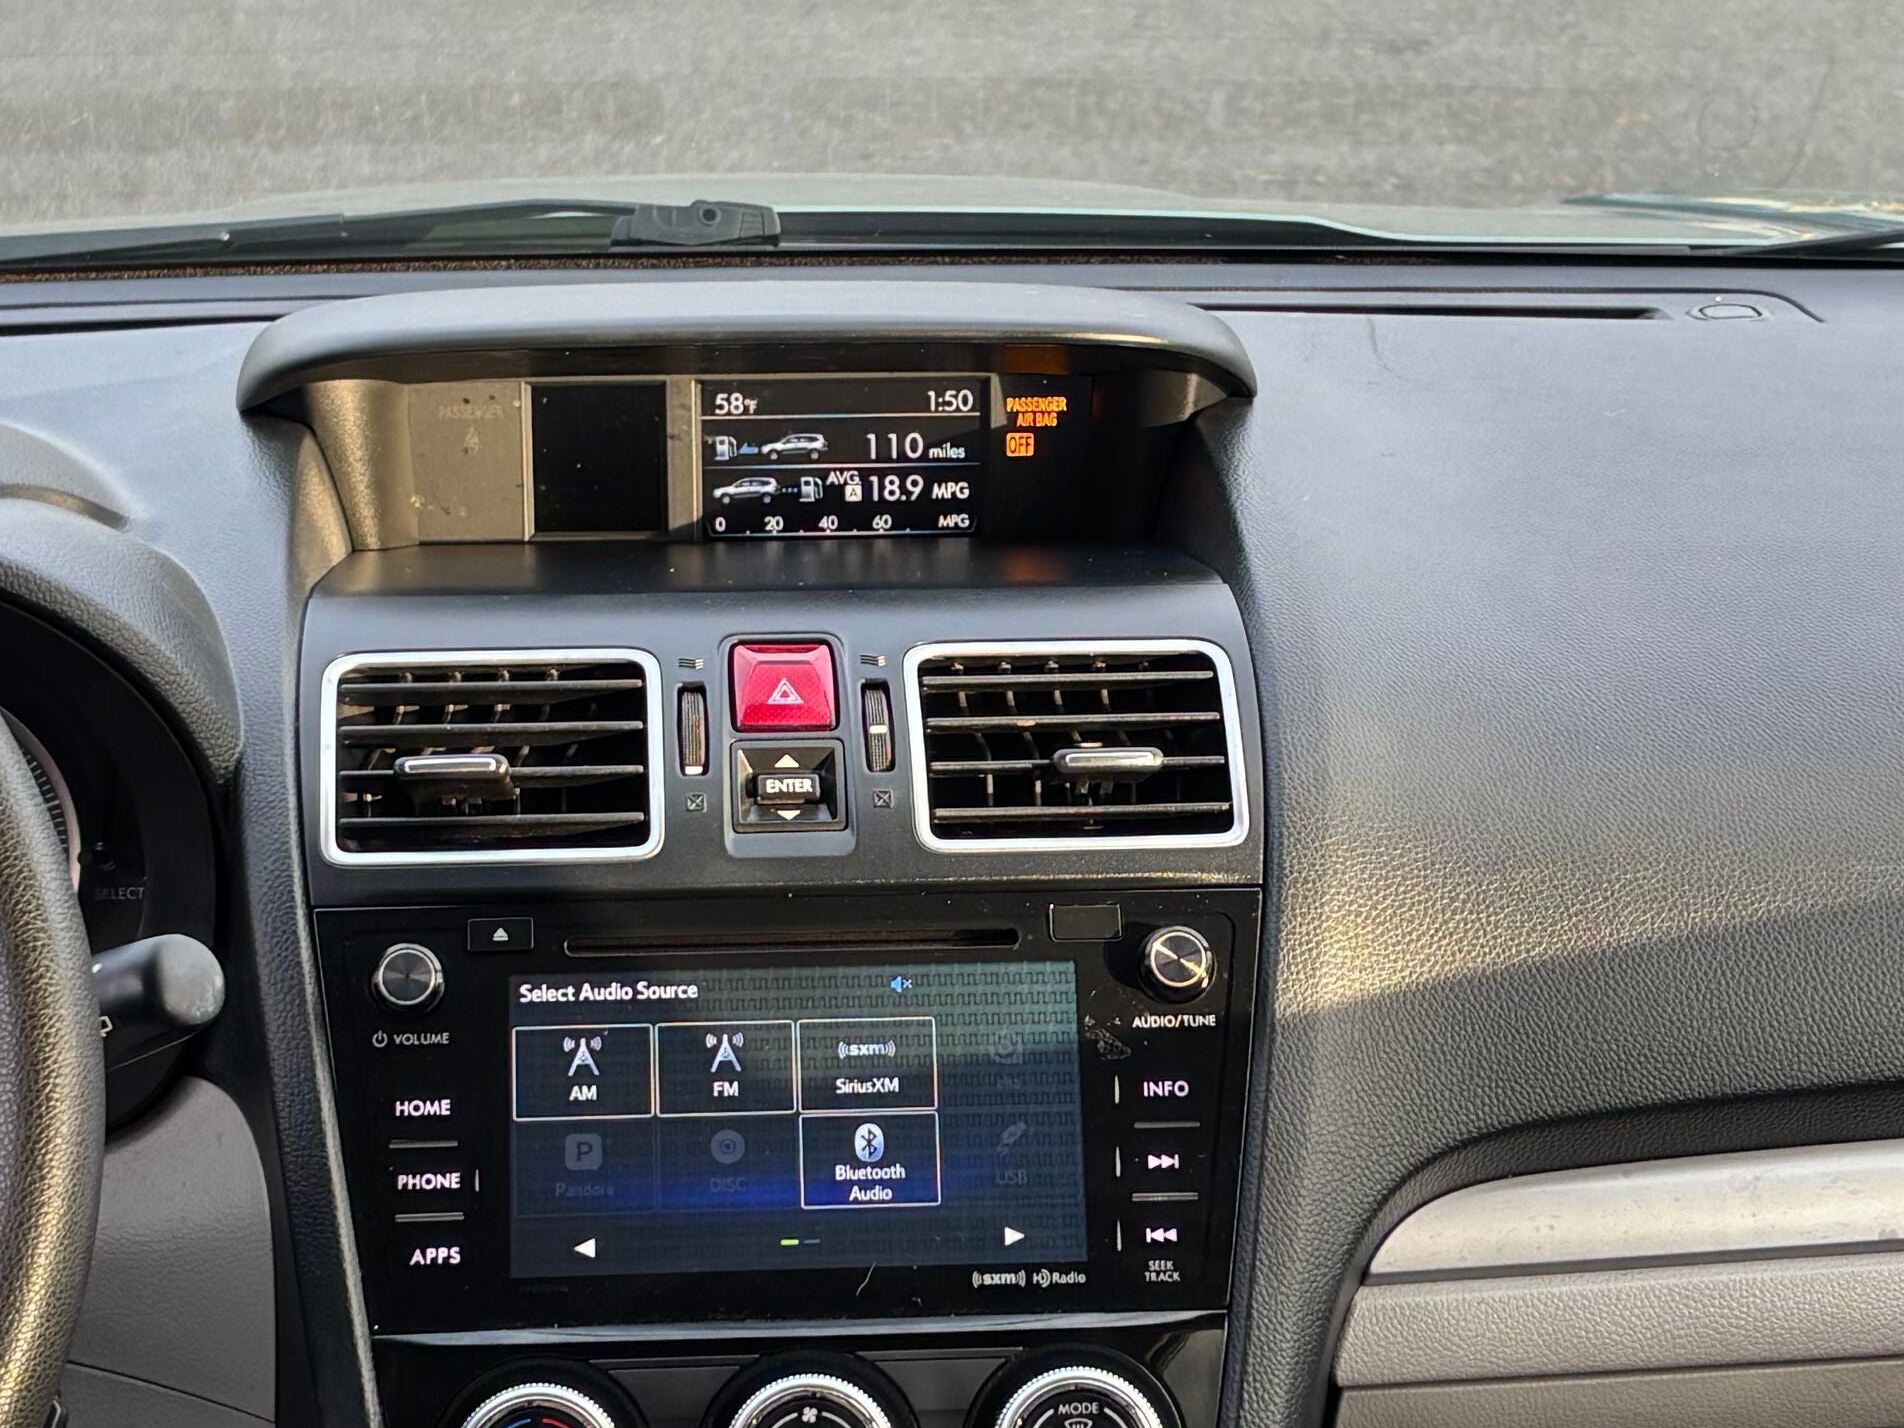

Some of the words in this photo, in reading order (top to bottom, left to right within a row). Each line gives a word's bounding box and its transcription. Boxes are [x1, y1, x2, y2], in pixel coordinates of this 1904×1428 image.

[928, 389, 973, 412] 1:50
[1006, 396, 1067, 413] PASSENGER
[1016, 412, 1035, 428] AIR
[1035, 412, 1058, 428] BAG
[866, 432, 924, 460] 110
[928, 443, 966, 460] miles
[1007, 435, 1034, 455] OFF
[868, 474, 924, 502] 18.9
[931, 482, 970, 501] MPG
[714, 516, 726, 532] 0
[764, 515, 784, 531] 20
[818, 515, 838, 530] 40
[872, 514, 892, 529] 60
[938, 513, 970, 528] MPG
[765, 778, 814, 795] ENTER
[96, 887, 144, 900] SELECT
[519, 983, 575, 1003] Select
[579, 982, 633, 1001] Audio
[636, 981, 699, 1000] Source
[1132, 1014, 1217, 1029] AUDIO/TUNE
[393, 1032, 450, 1046] VOLUME
[568, 1084, 598, 1103] AM
[712, 1080, 740, 1098] FM
[835, 1076, 900, 1094] SiriusXM
[1143, 1080, 1190, 1098] INFO
[395, 1098, 451, 1117] HOME
[397, 1172, 461, 1190] PHONE
[834, 1164, 907, 1182] Bluetooth
[708, 1176, 748, 1193] DISC
[848, 1184, 894, 1202] Audio
[409, 1246, 461, 1266] APPS
[1147, 1260, 1175, 1272] SEEK
[1051, 1271, 1087, 1285] Radio
[1144, 1272, 1181, 1283] TRACK
[1057, 1401, 1101, 1416] MODE
